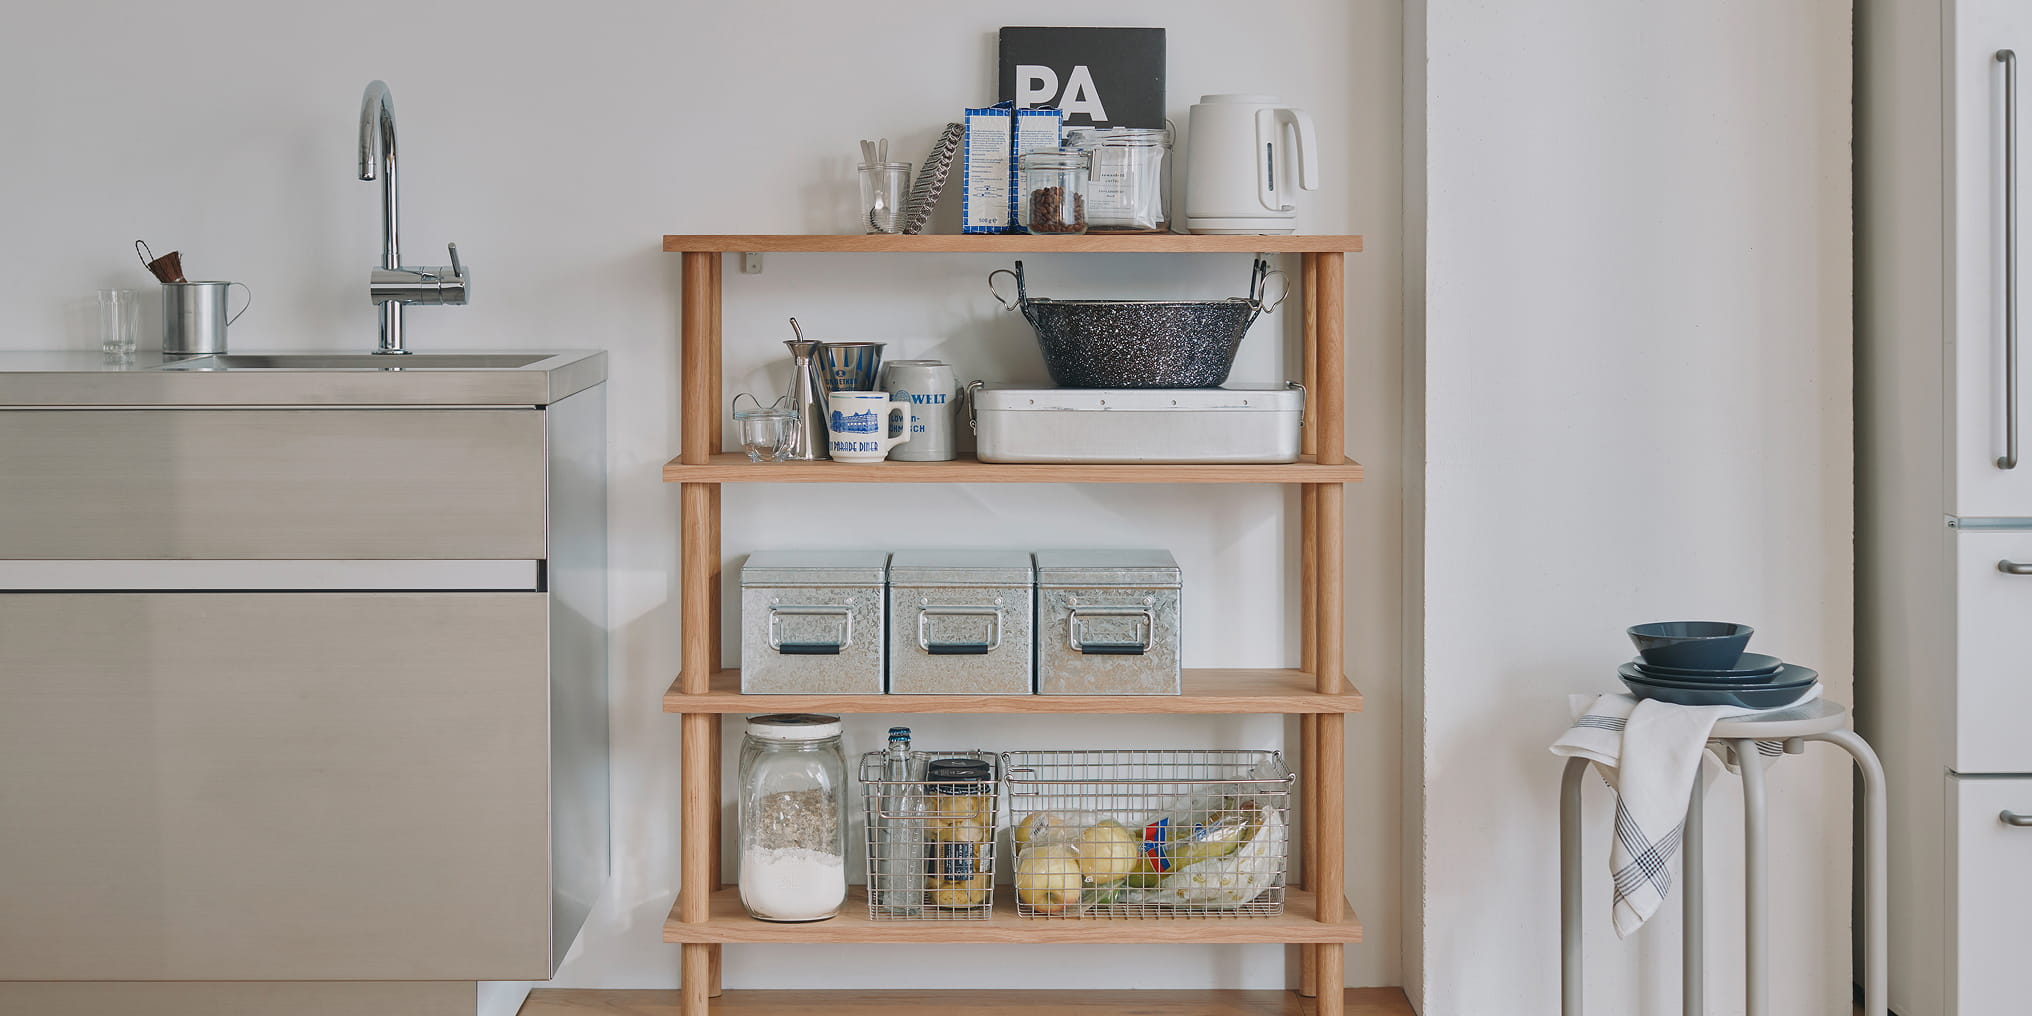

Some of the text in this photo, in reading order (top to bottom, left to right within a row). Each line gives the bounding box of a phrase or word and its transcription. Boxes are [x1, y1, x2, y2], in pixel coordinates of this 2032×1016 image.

[1016, 64, 1109, 122] PA
[911, 393, 947, 404] WELT
[859, 441, 879, 452] DINER
